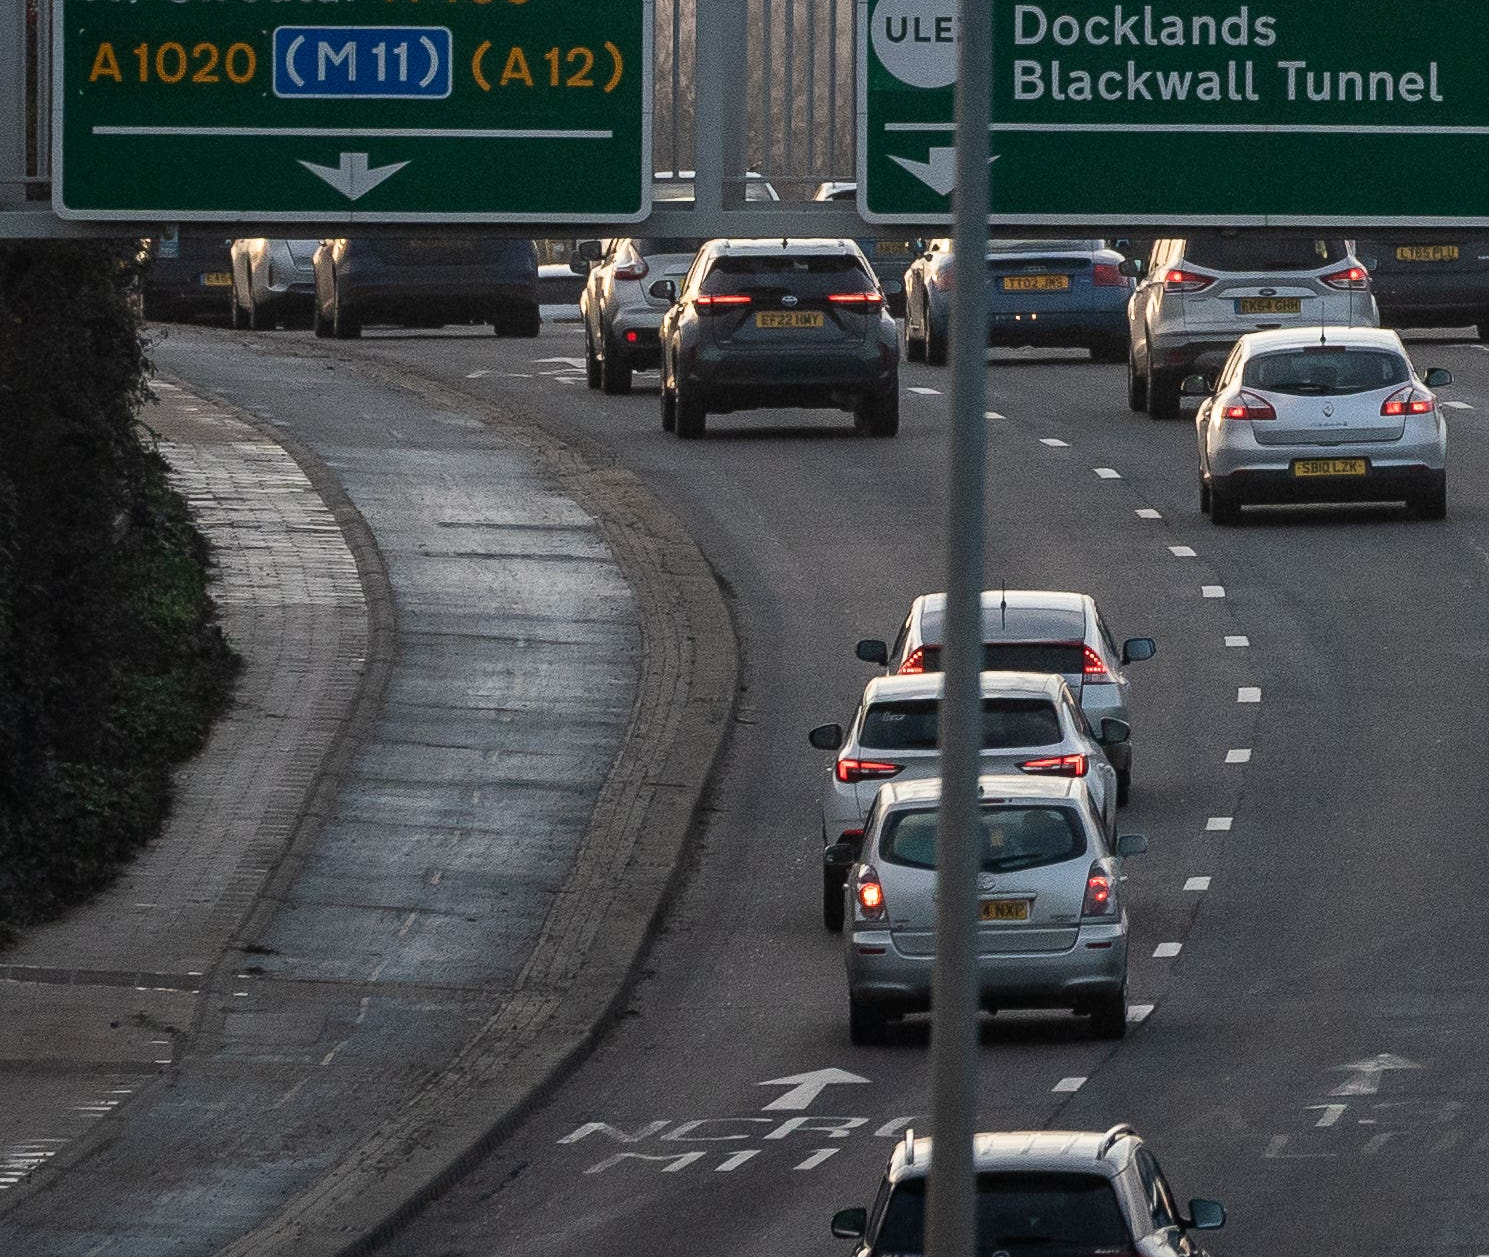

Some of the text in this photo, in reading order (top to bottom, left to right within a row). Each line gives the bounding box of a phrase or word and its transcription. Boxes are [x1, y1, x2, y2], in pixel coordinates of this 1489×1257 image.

[885, 16, 956, 43] ULE
[1013, 5, 1277, 48] Docklands
[88, 41, 257, 84] A1020
[471, 40, 625, 93] (A12)
[1013, 59, 1445, 103] Blackwall Tunnel
[583, 1147, 841, 1174] M11
